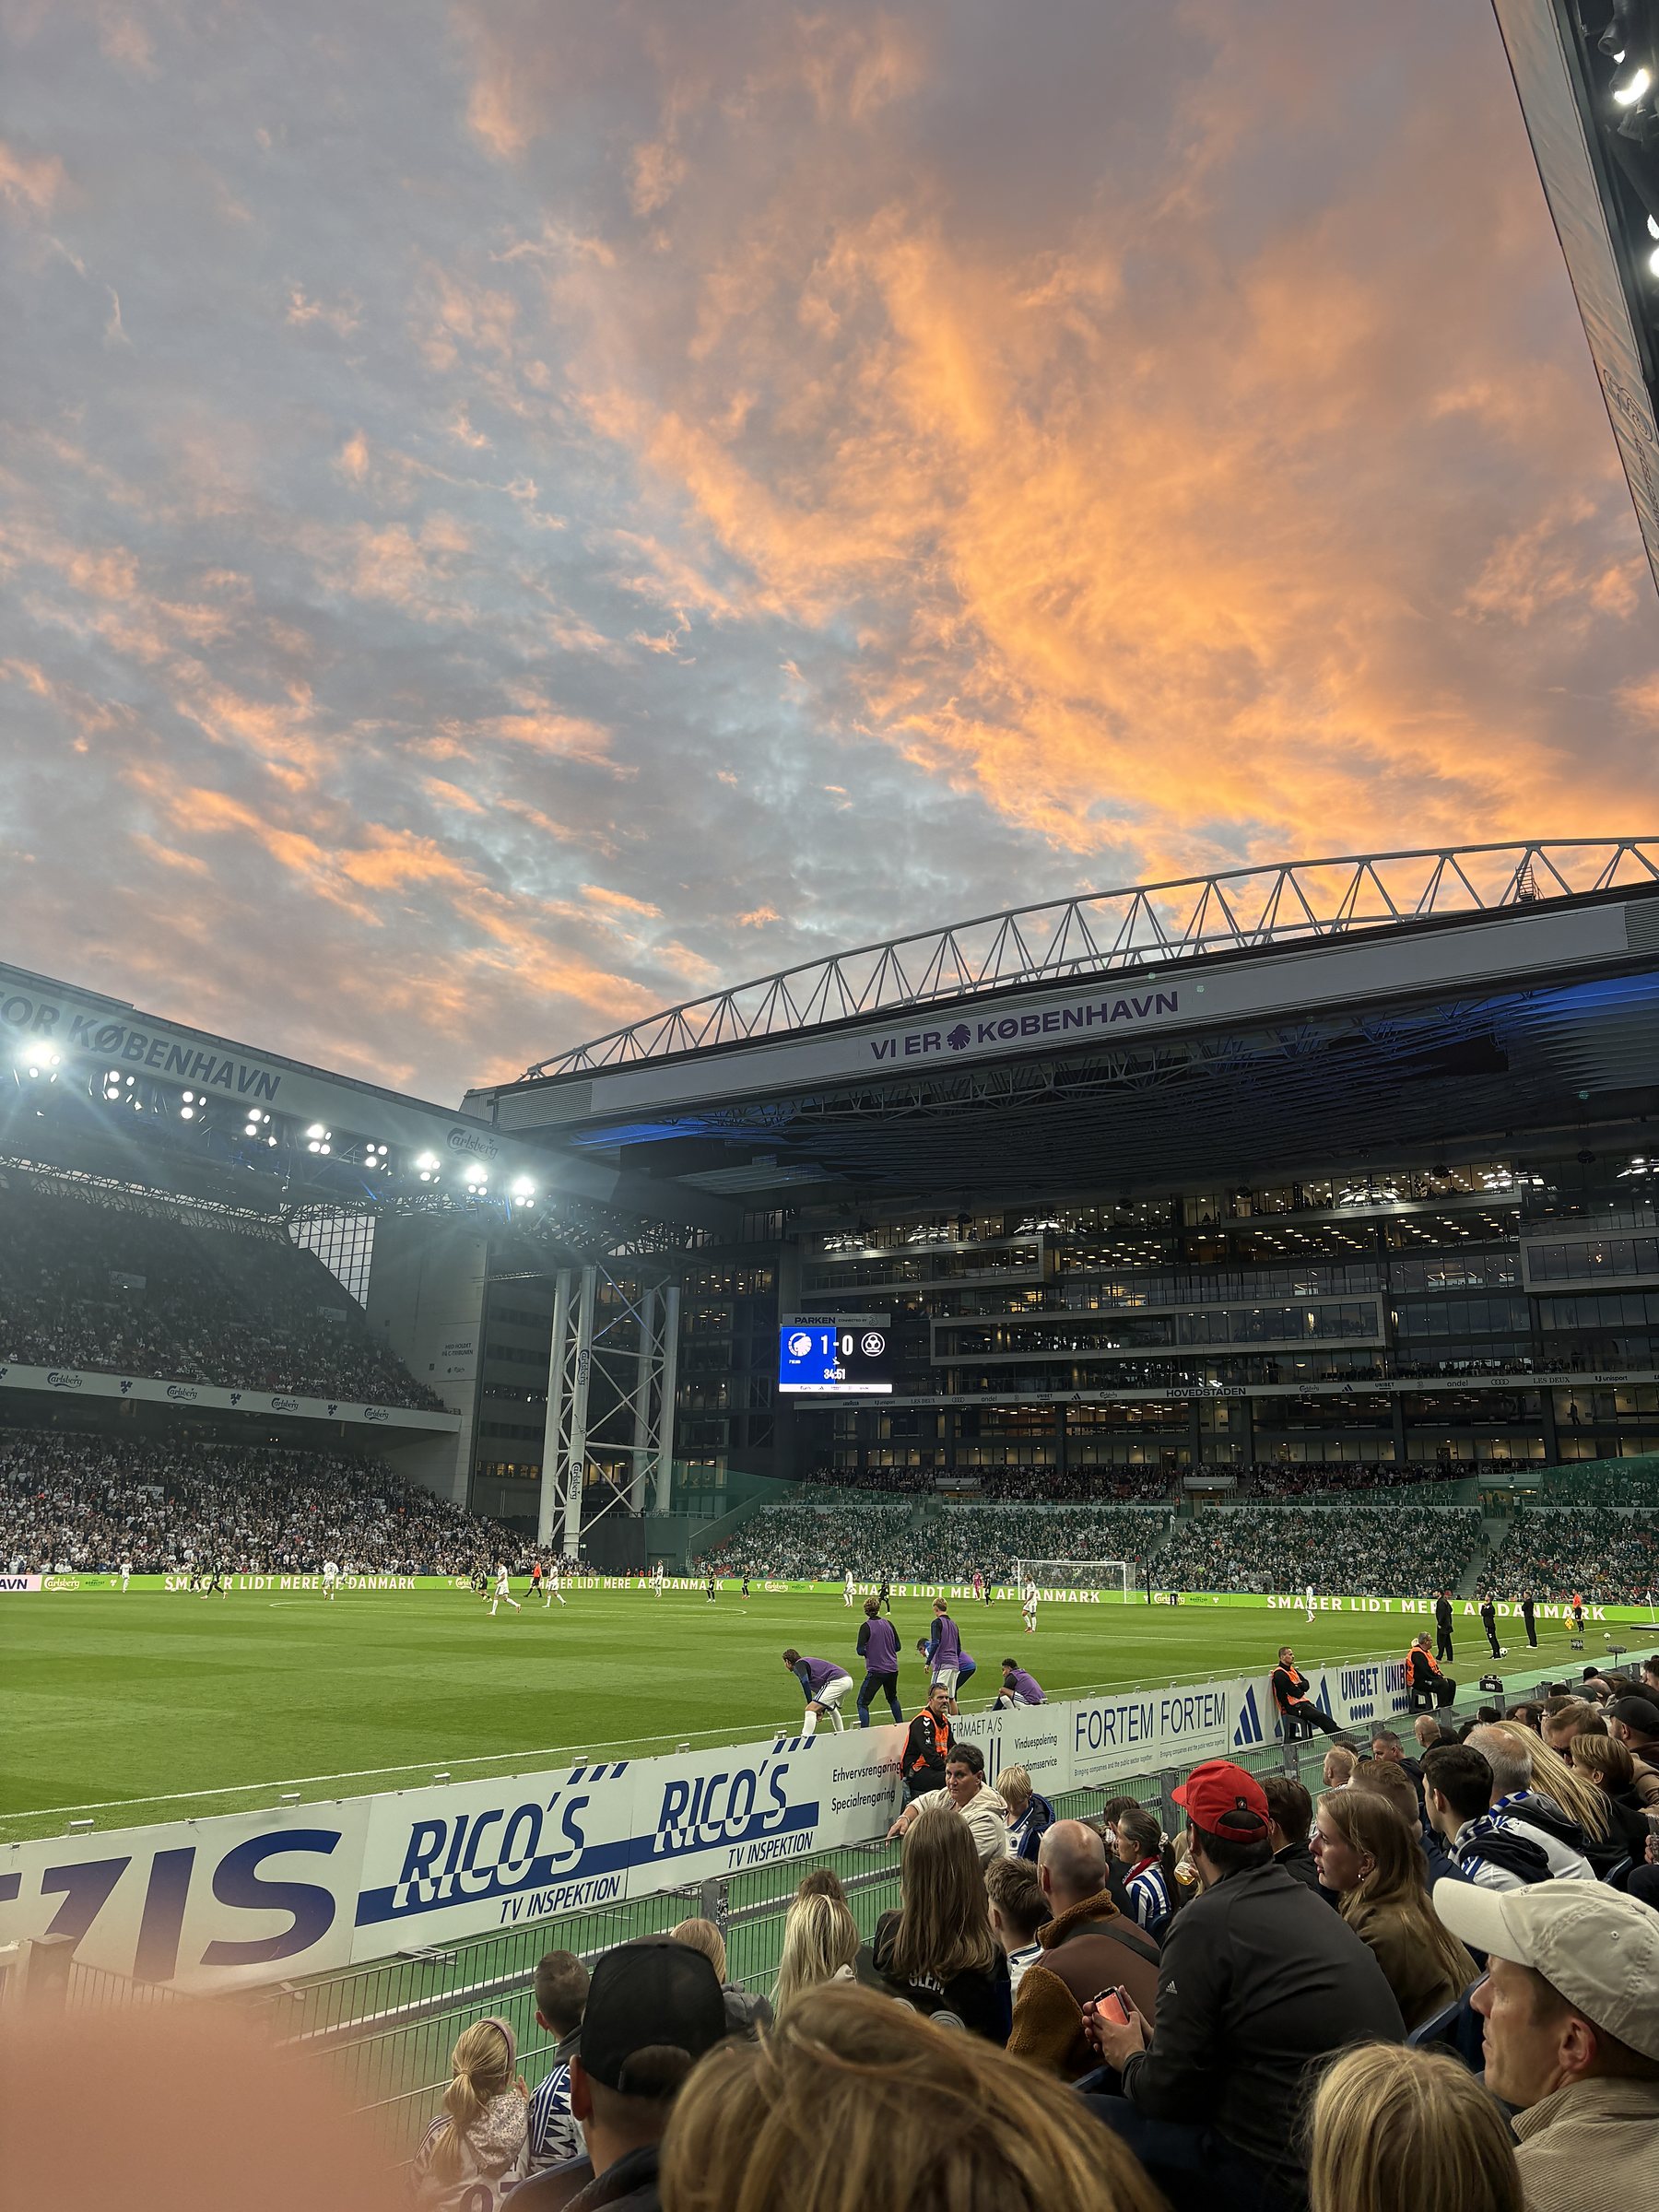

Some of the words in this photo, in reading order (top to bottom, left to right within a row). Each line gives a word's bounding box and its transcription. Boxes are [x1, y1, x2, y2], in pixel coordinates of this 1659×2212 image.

[870, 1039, 896, 1060] VI
[905, 1031, 941, 1055] ER
[978, 991, 1178, 1042] KØBENHAVN
[67, 1015, 281, 1101] KØBENHAVN
[447, 1127, 499, 1160] Carlsberg
[578, 1348, 590, 1386] Carlsberg
[47, 1371, 83, 1388] Carlsberg
[167, 1385, 197, 1400] Carlsberg
[1166, 1387, 1246, 1397] HOVEDSTADEN
[271, 1397, 299, 1412] Carlsberg
[364, 1407, 389, 1421] Carlsberg
[570, 1462, 582, 1500] Carlsberg
[43, 1577, 80, 1591] Carlsberg
[241, 1577, 274, 1590] LIDT
[280, 1577, 319, 1589] MERE
[349, 1577, 416, 1589] DANMARK
[578, 1578, 599, 1589] LIDT
[604, 1578, 631, 1589] MERE
[765, 1581, 788, 1593] Carlsberg
[913, 1586, 945, 1597] LIDT
[996, 1588, 1015, 1600] AF
[1267, 1596, 1343, 1610] SMAGER
[1351, 1598, 1393, 1612] LIDT
[1341, 1667, 1378, 1700] UNIBET
[1160, 1692, 1225, 1735] FORTEM
[950, 1717, 985, 1737] FIRMAET
[987, 1716, 1003, 1735] A/S
[1076, 1702, 1153, 1752] FORTEM
[1015, 1733, 1057, 1749] Vinduespolering
[832, 1759, 901, 1783] Erhvervsrengøring
[1089, 1764, 1107, 1772] companies
[1120, 1758, 1130, 1767] public
[653, 1759, 789, 1853] RICO'S
[831, 1787, 895, 1815] Specialrengøring
[392, 1791, 591, 1909] RICO'S
[728, 1846, 745, 1869] TV
[746, 1831, 813, 1865] INSPEKTION
[500, 1897, 524, 1924] TV
[527, 1875, 620, 1918] INSPEKTION
